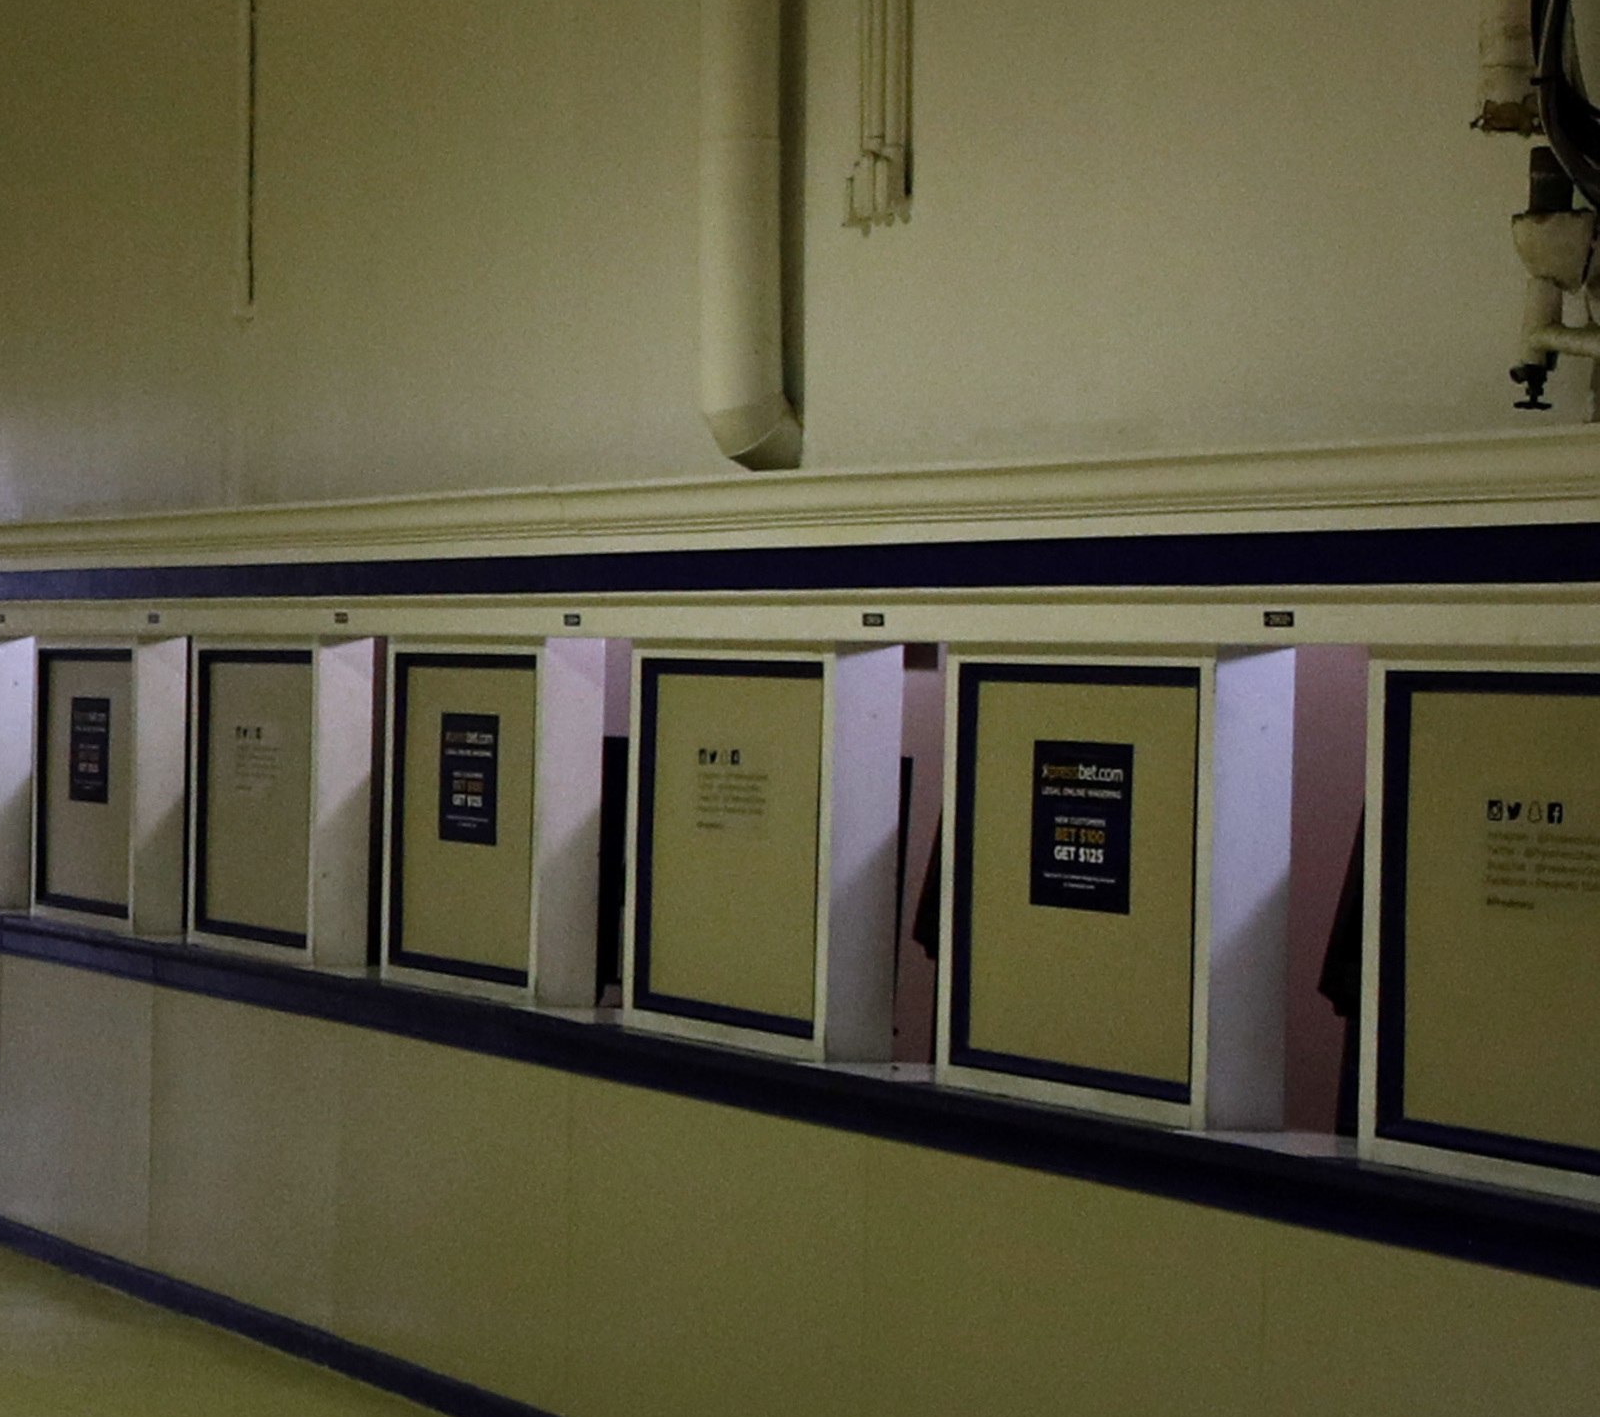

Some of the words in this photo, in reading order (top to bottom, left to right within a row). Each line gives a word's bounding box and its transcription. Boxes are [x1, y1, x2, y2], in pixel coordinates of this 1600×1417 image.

[1055, 826, 1078, 842] BET
[1054, 844, 1077, 862] GET
[1077, 846, 1104, 864] $125
